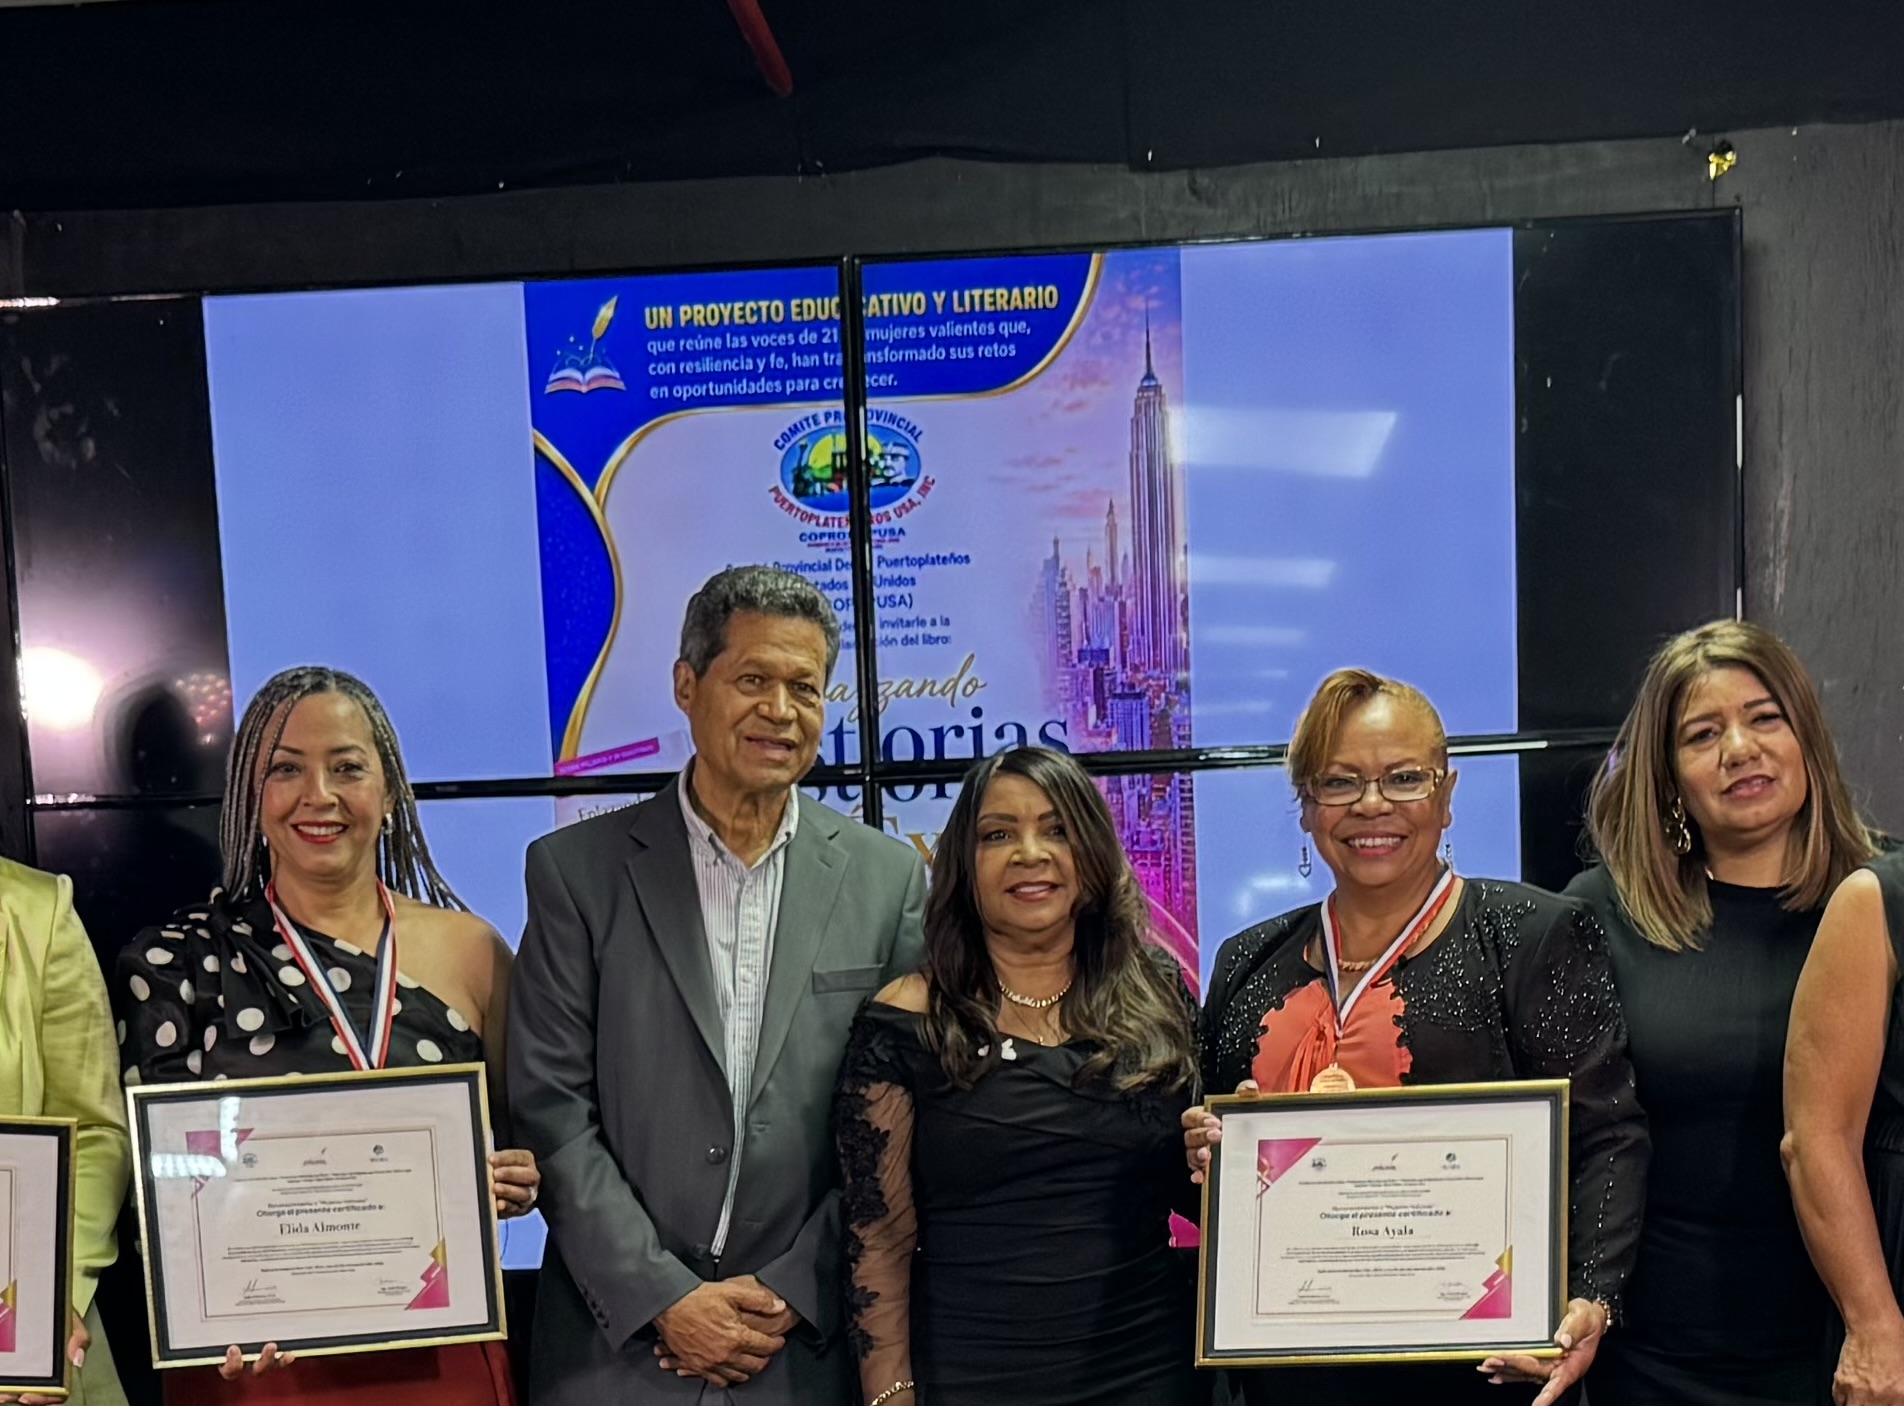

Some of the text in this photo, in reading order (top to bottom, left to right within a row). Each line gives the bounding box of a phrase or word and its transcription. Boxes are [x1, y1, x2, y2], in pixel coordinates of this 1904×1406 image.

[645, 306, 673, 329] UN
[679, 299, 785, 327] PROYECTO
[932, 291, 946, 314] Y
[952, 285, 1059, 313] LITERARIO
[647, 319, 1032, 355] que reúne las voces de 21 mujeres valientes que,
[648, 361, 676, 376] con
[679, 355, 754, 374] resiliencia
[756, 357, 767, 374] y
[769, 353, 789, 371] fe,
[792, 352, 820, 368] han
[949, 346, 975, 360] sus
[978, 343, 1017, 359] retos
[650, 386, 669, 400] en
[672, 377, 783, 401] oportunidades
[786, 377, 820, 396] para
[774, 412, 821, 451] COMITE
[877, 552, 971, 570] Puertoplateños
[901, 633, 919, 647] del
